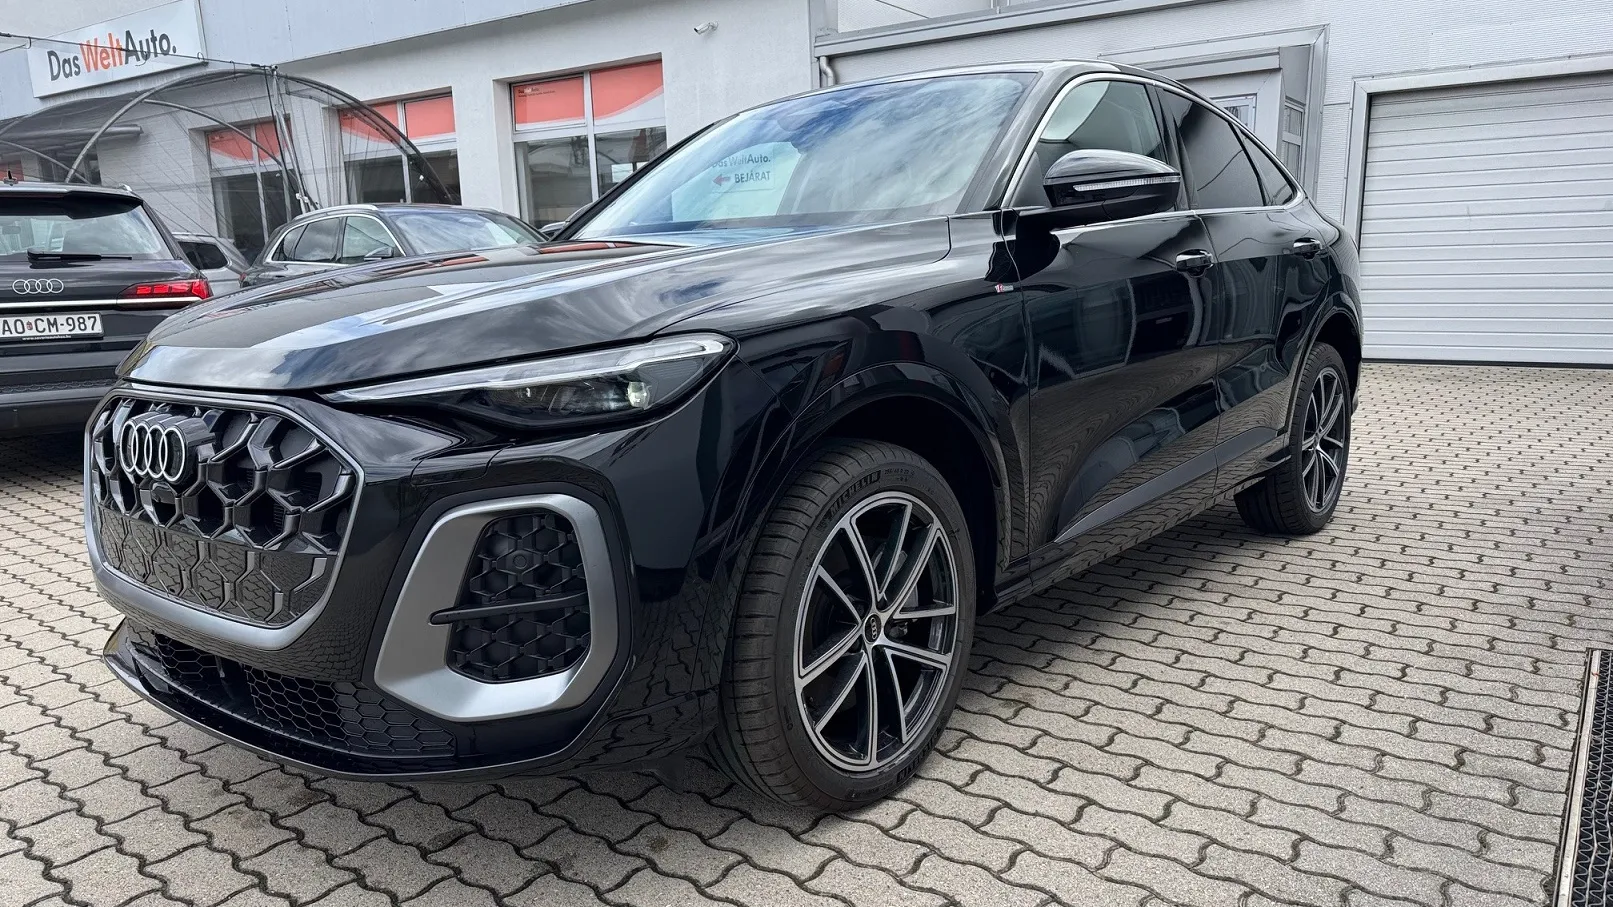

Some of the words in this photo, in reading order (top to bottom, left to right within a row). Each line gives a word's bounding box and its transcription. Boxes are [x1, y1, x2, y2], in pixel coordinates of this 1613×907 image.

[47, 51, 81, 81] Das
[80, 29, 177, 73] WeltAuto.
[734, 170, 771, 184] BEJÁRAT
[2, 319, 26, 336] AO
[34, 316, 97, 333] CM-987
[829, 469, 882, 518] MICHELIN
